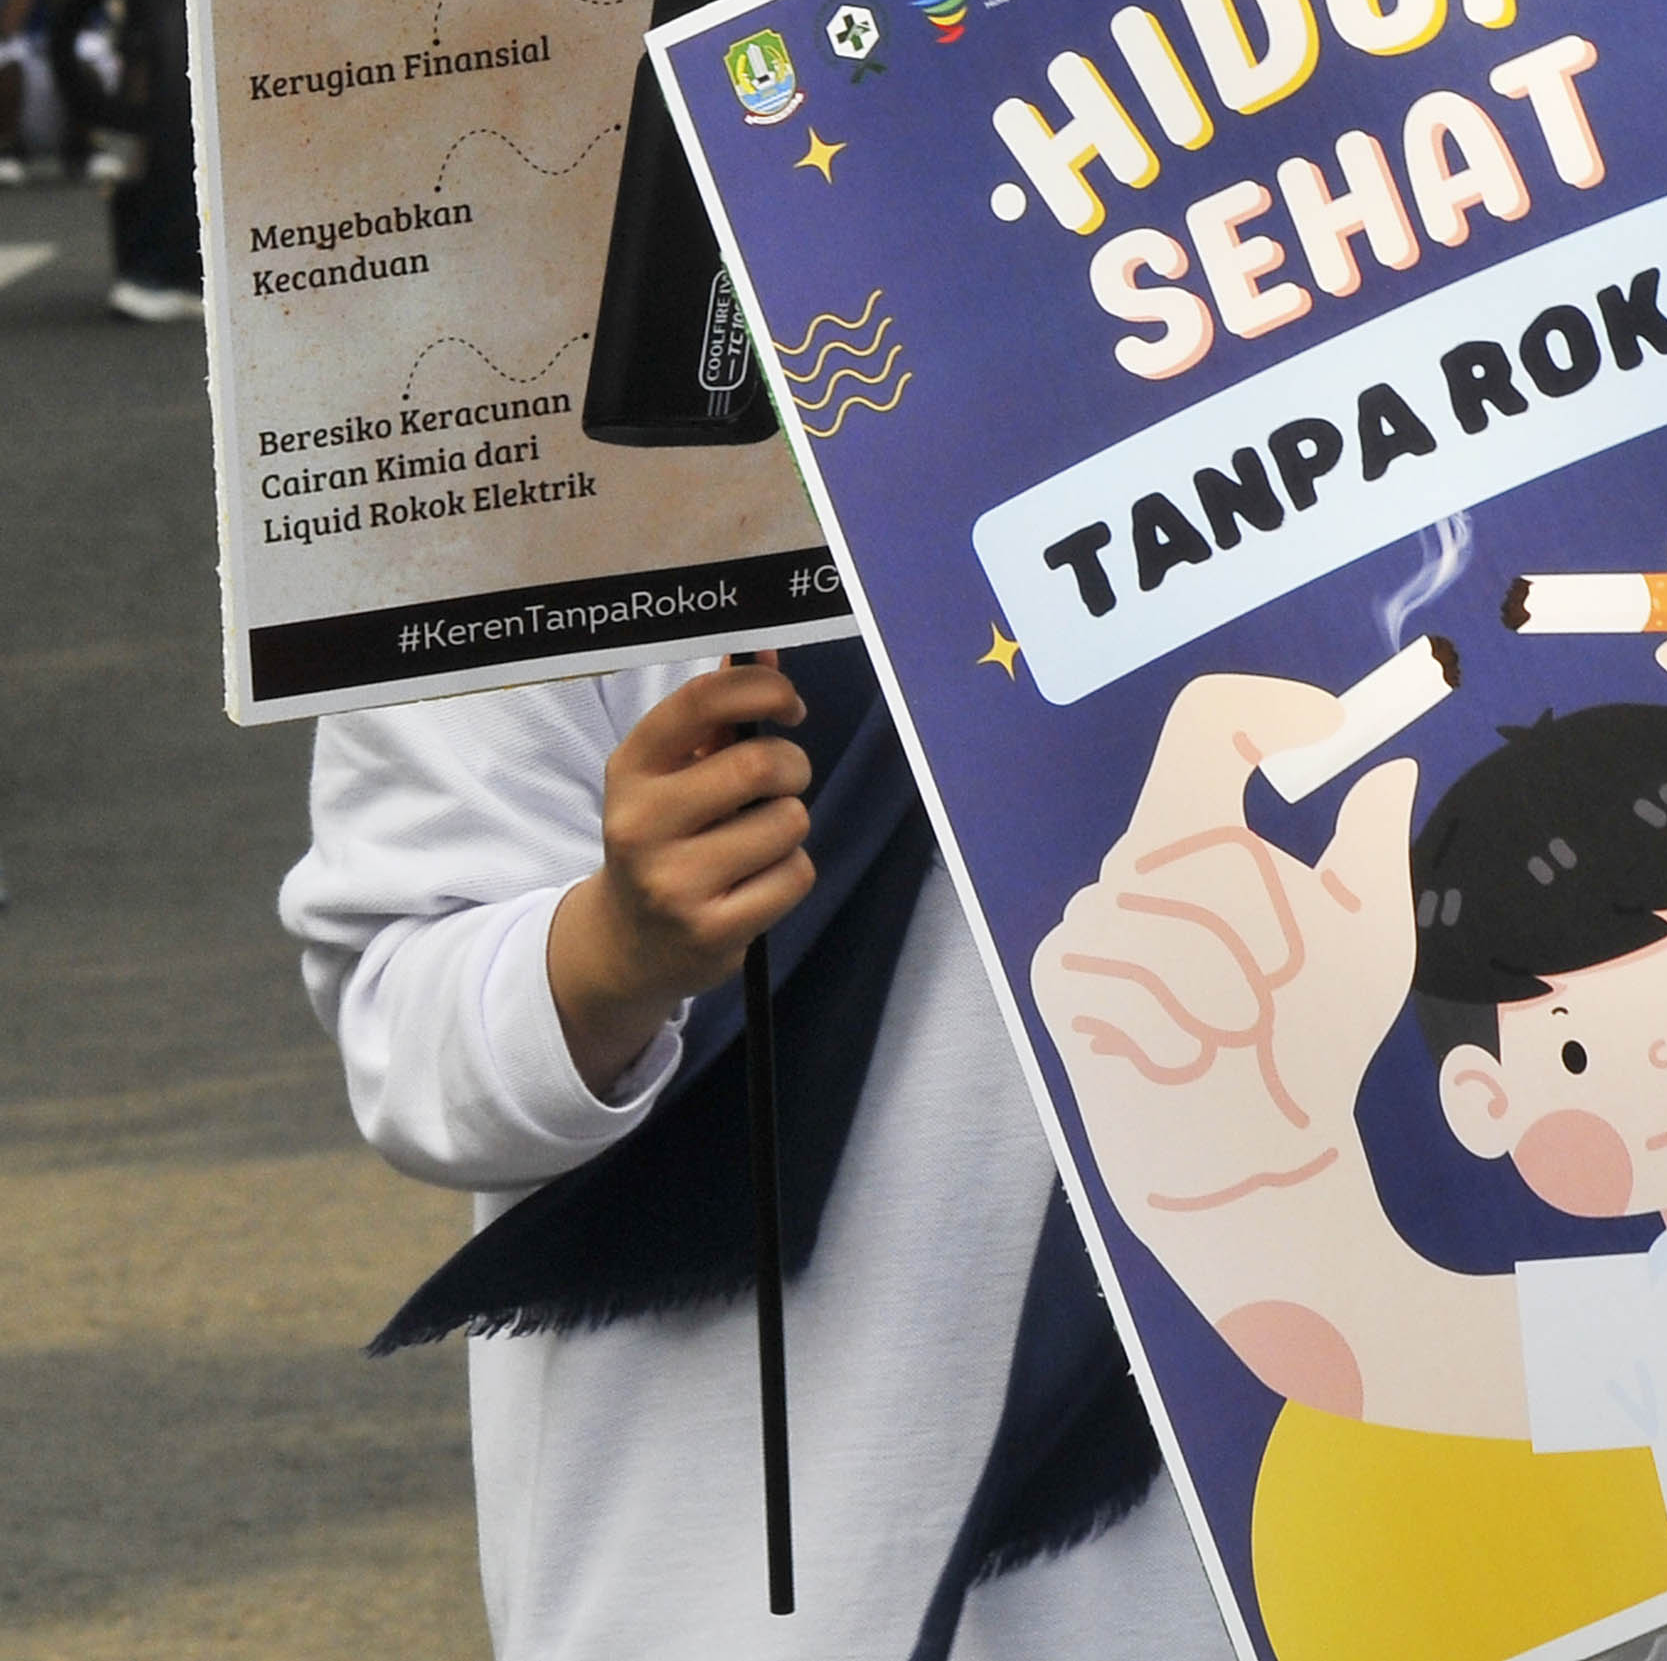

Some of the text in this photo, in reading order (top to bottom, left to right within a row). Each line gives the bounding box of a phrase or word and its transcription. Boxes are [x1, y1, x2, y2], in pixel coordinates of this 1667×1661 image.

[248, 34, 552, 101] Kerugian Finansial
[248, 197, 474, 254] Menyebabkan
[1086, 34, 1608, 381] SEHAT
[252, 249, 431, 297] Kecanduan
[257, 388, 573, 458] Beresiko Keracunan
[260, 433, 540, 501] Cairan Kimia dari
[263, 471, 599, 546] Liquid Rokok Elektrik
[1043, 397, 1438, 621] TANPA
[397, 563, 844, 655] #KerenTanpaRokok #G
